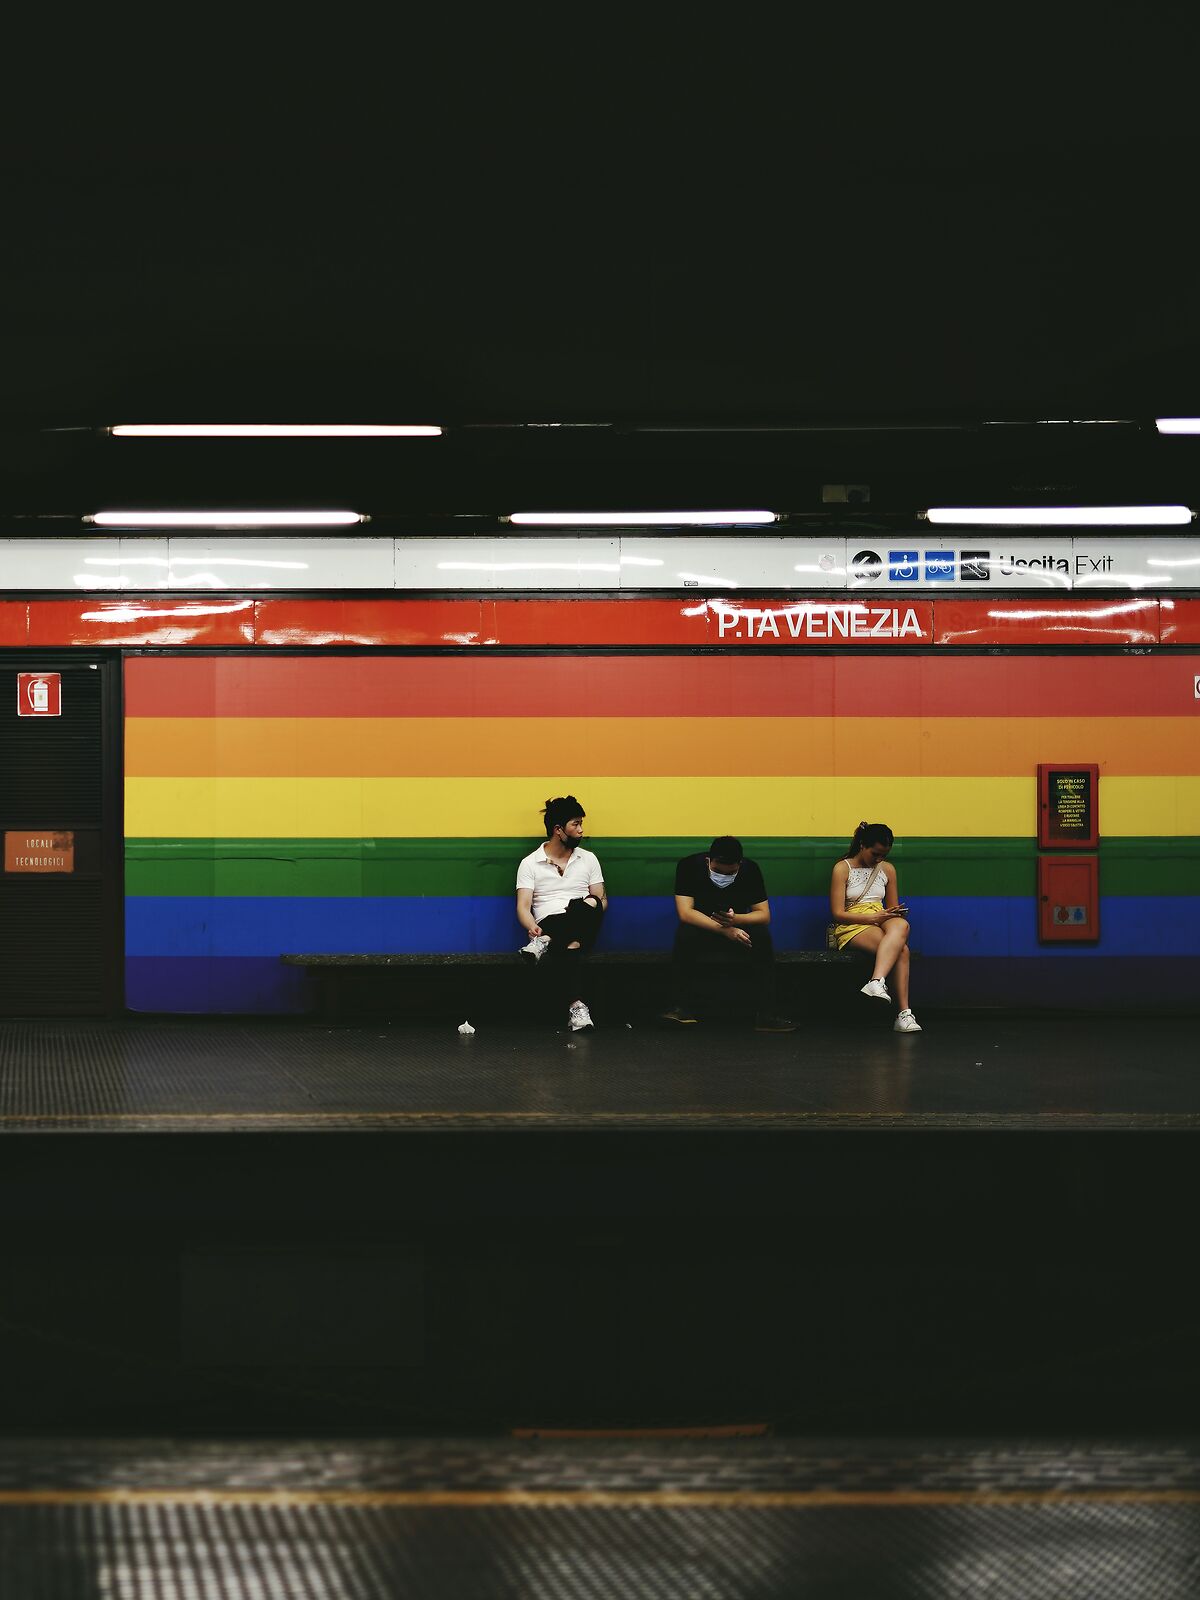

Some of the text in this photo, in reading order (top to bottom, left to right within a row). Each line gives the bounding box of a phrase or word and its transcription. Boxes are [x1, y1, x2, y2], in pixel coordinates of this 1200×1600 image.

[1000, 555, 1114, 576] Uscita Exit
[718, 608, 780, 638] P.TA
[782, 608, 923, 638] VENEZIA
[26, 839, 53, 848] LOCALI
[15, 857, 64, 866] TECNOLOGICI
